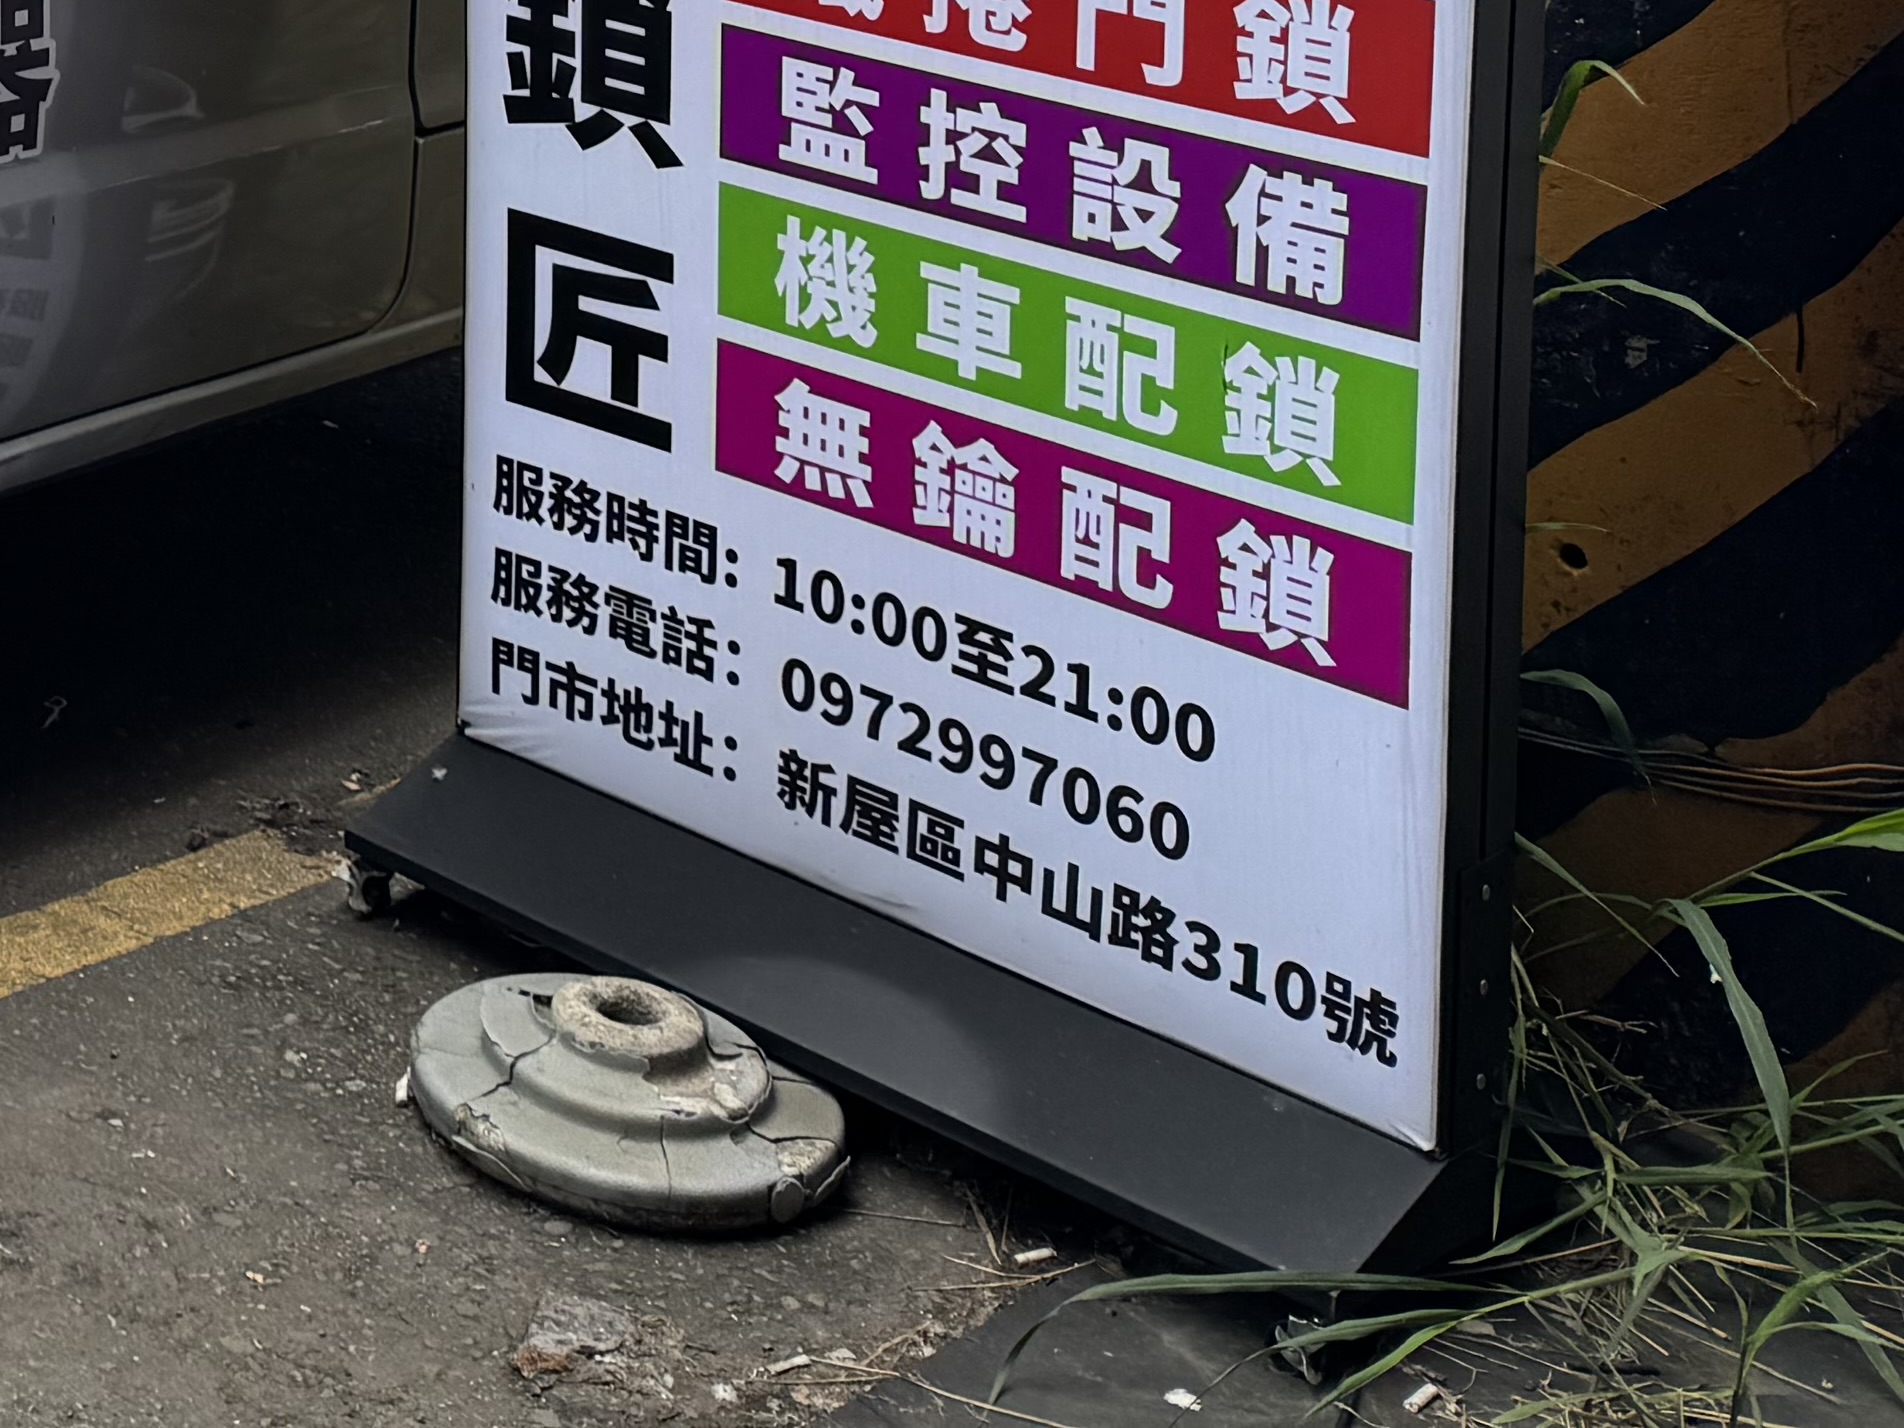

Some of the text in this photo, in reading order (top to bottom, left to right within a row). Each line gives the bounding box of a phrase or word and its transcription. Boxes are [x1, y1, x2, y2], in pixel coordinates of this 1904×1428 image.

[778, 54, 1351, 305] 監控設備
[774, 214, 1341, 487] 機車配鎖
[492, 453, 1217, 763] 服務時間： 10:00至21:00
[772, 377, 1339, 668] 無鑰配鎖
[491, 546, 1191, 861] 服務電話： 0972997060
[491, 636, 1400, 1069] 門市地址： 新屋區中山路310號
